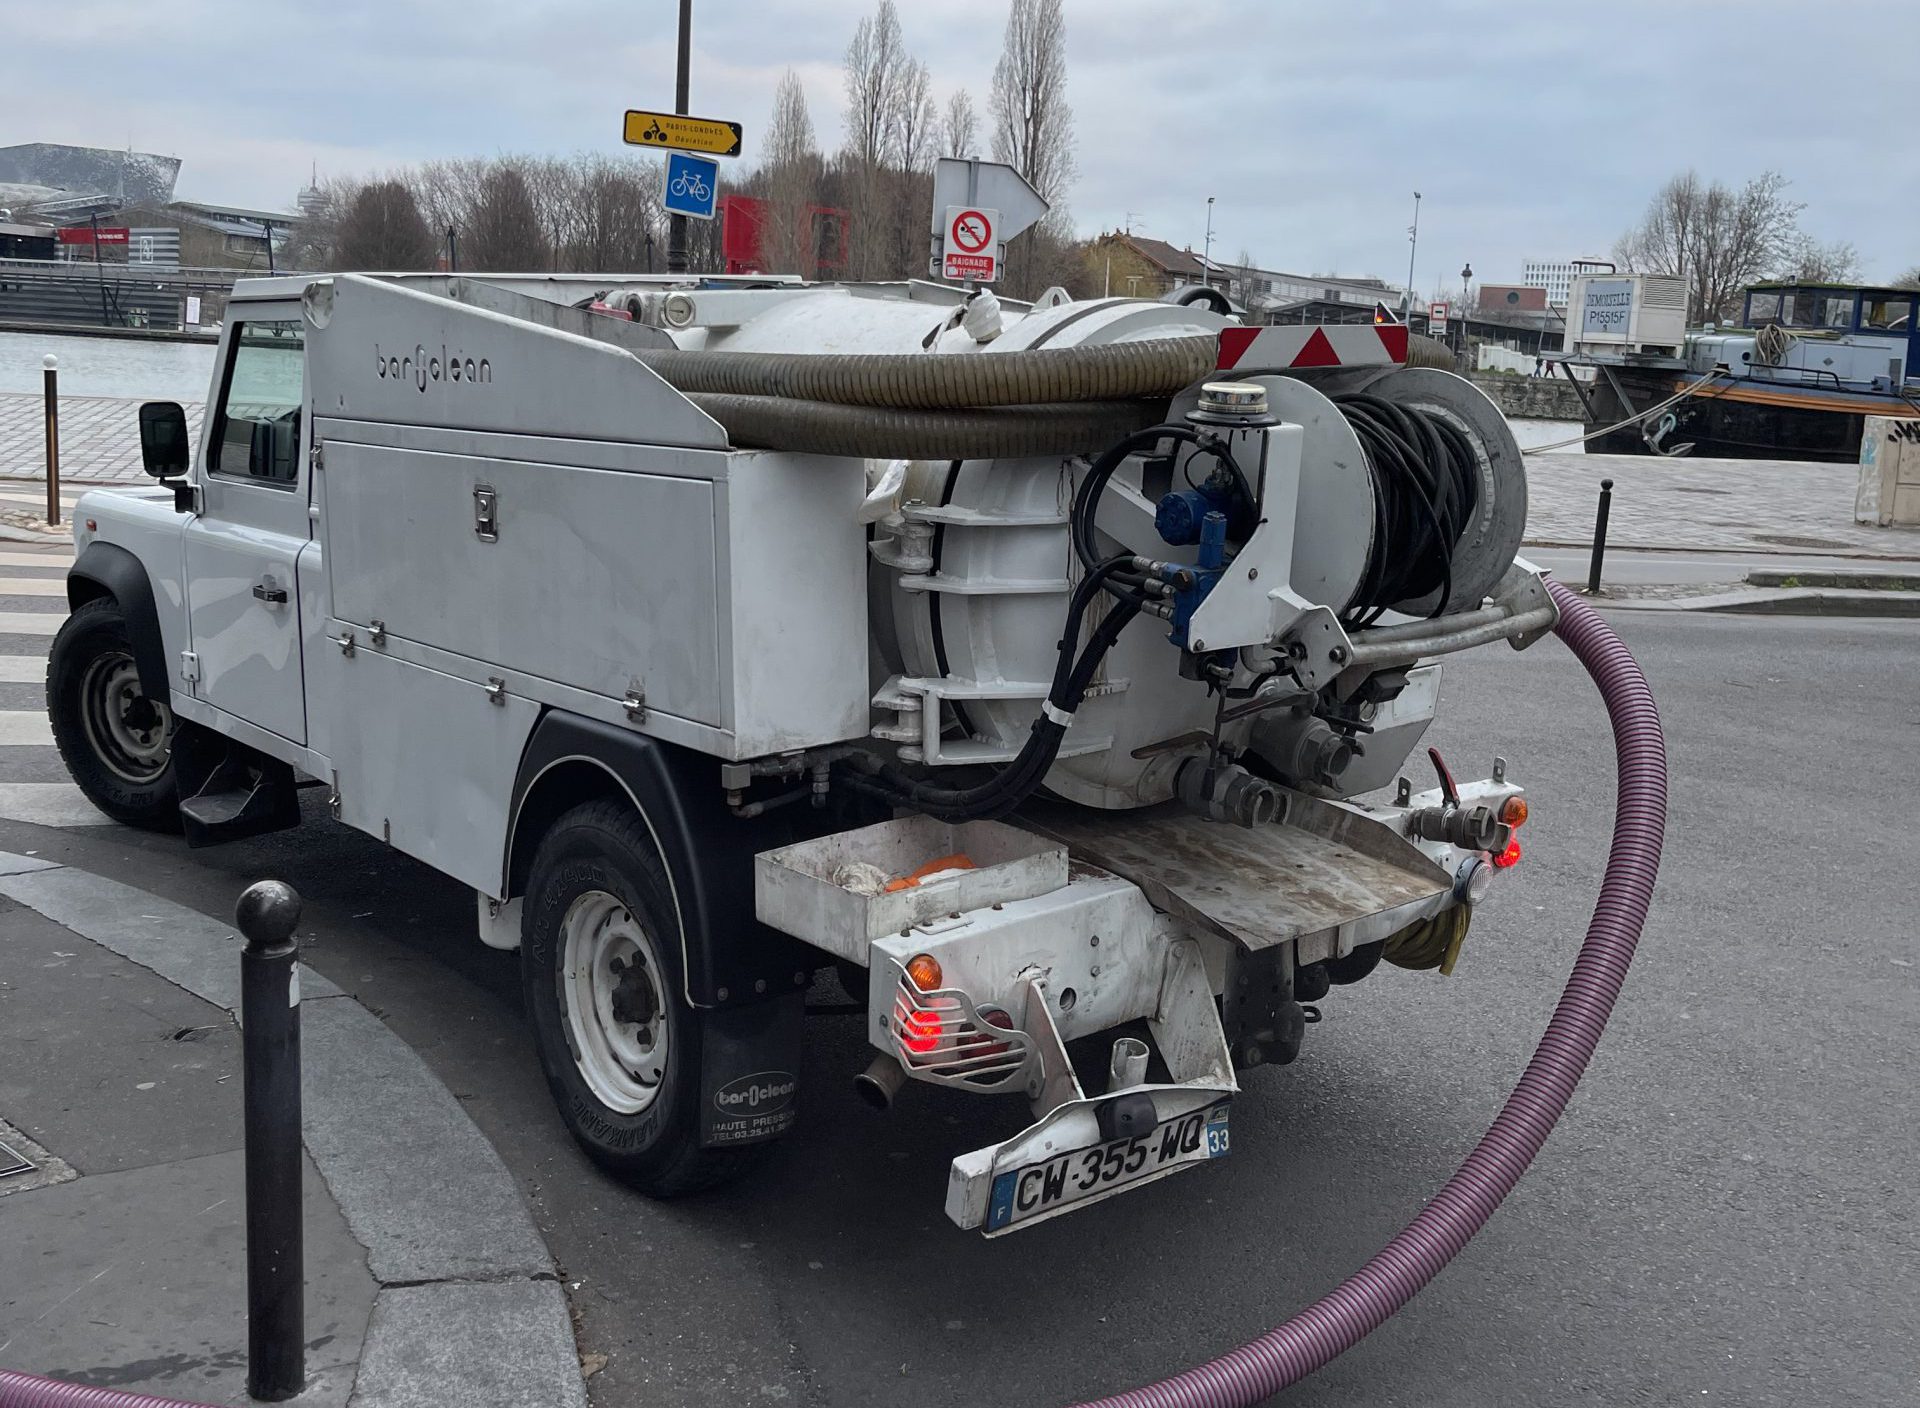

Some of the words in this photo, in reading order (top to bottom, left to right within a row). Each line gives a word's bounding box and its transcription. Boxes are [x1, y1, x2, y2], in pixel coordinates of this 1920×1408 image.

[952, 257, 988, 267] BAIGNADE
[1586, 292, 1631, 306] DEMOISELLE
[712, 1121, 747, 1131] HAUTE
[1209, 1128, 1230, 1153] 33
[1016, 1114, 1204, 1212] CW-355-WQ
[996, 1206, 1007, 1221] F
